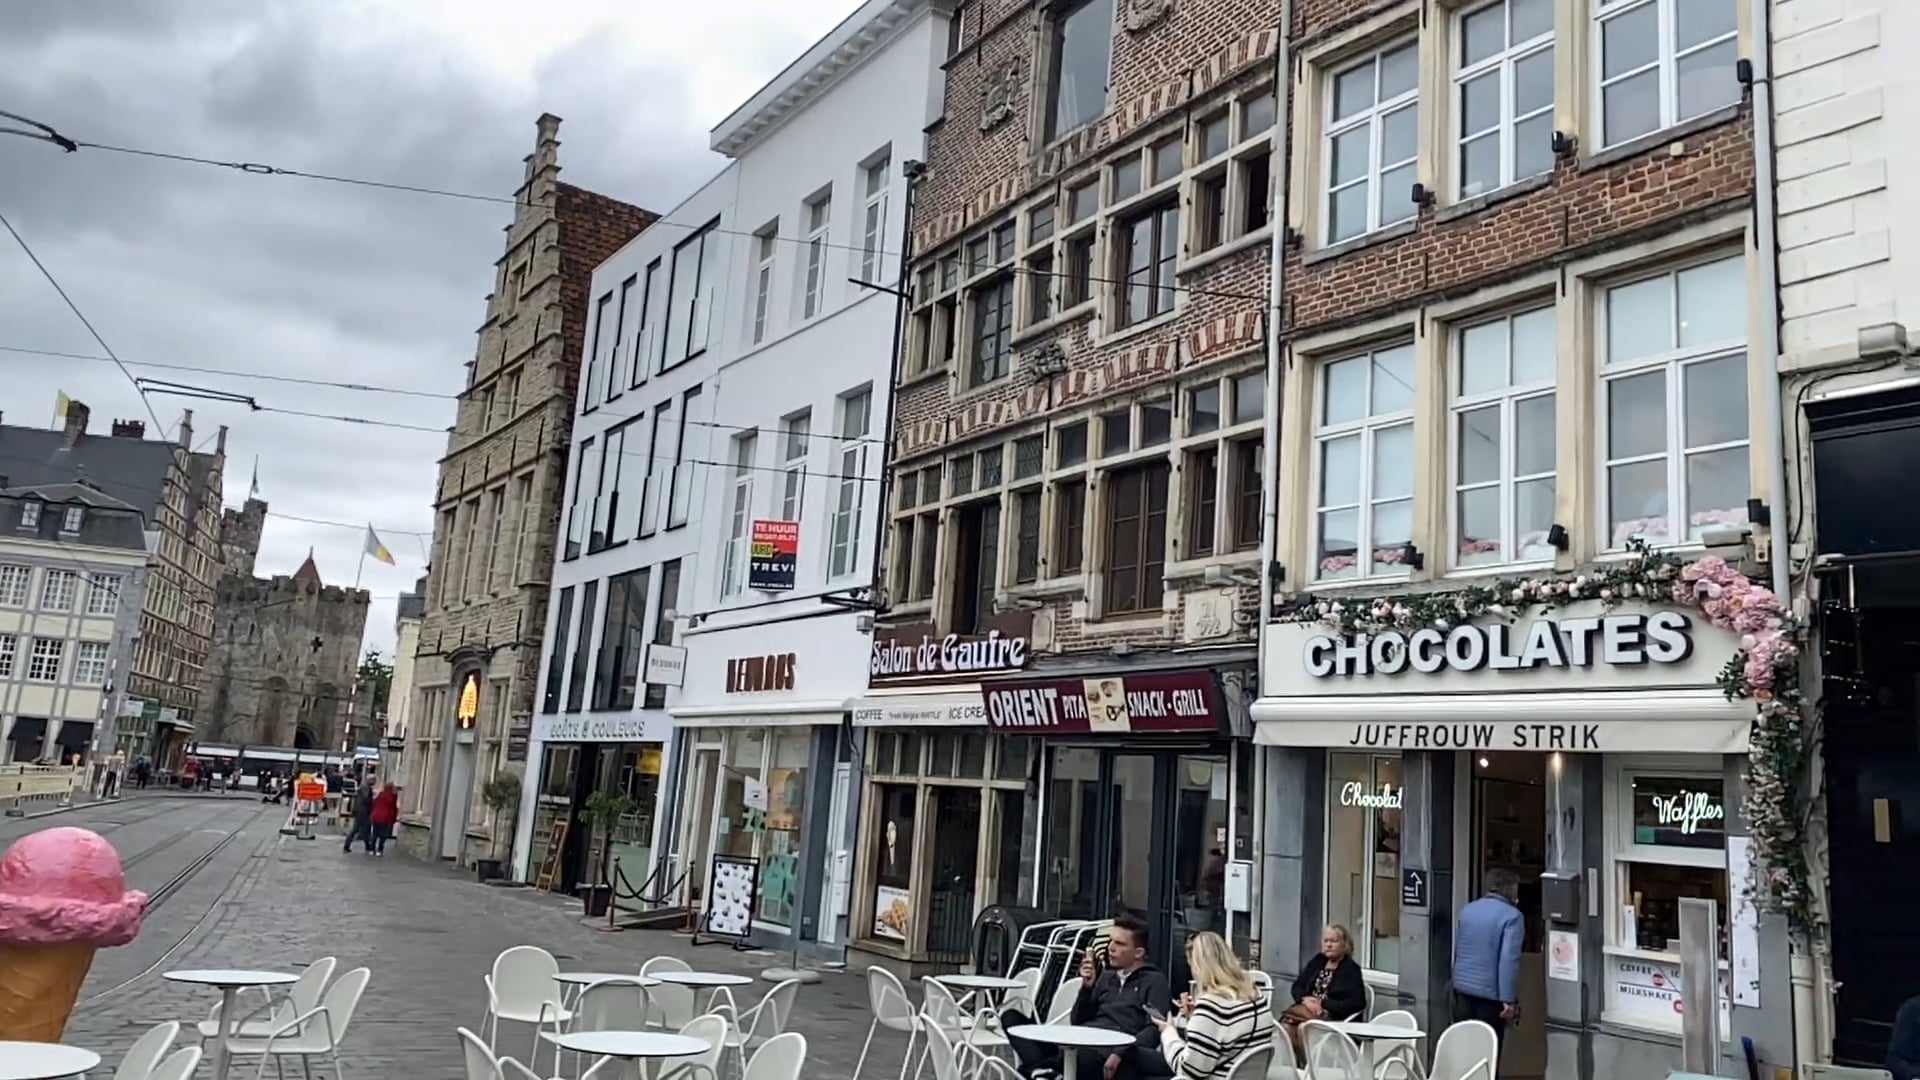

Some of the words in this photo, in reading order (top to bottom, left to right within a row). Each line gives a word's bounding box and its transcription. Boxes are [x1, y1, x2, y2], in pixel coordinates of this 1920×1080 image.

[755, 523, 767, 532] TE
[768, 524, 798, 534] HUUR
[752, 562, 795, 573] TREVI
[872, 638, 912, 675] Salon
[917, 635, 938, 671] de
[941, 630, 1026, 672] Gaufre
[1303, 611, 1693, 679] CHOCOLATES
[855, 708, 883, 720] COFFEE
[949, 707, 962, 719] ICE
[989, 688, 1060, 727] ORIENT
[1062, 695, 1088, 720] PITA
[1350, 724, 1495, 749] JUFFROUW
[1513, 724, 1600, 749] STRIK
[1341, 781, 1403, 809] Chocolat
[1652, 789, 1724, 834] Waffles
[1620, 963, 1652, 975] COFFEE
[1620, 986, 1673, 1000] MILKSHAKE
